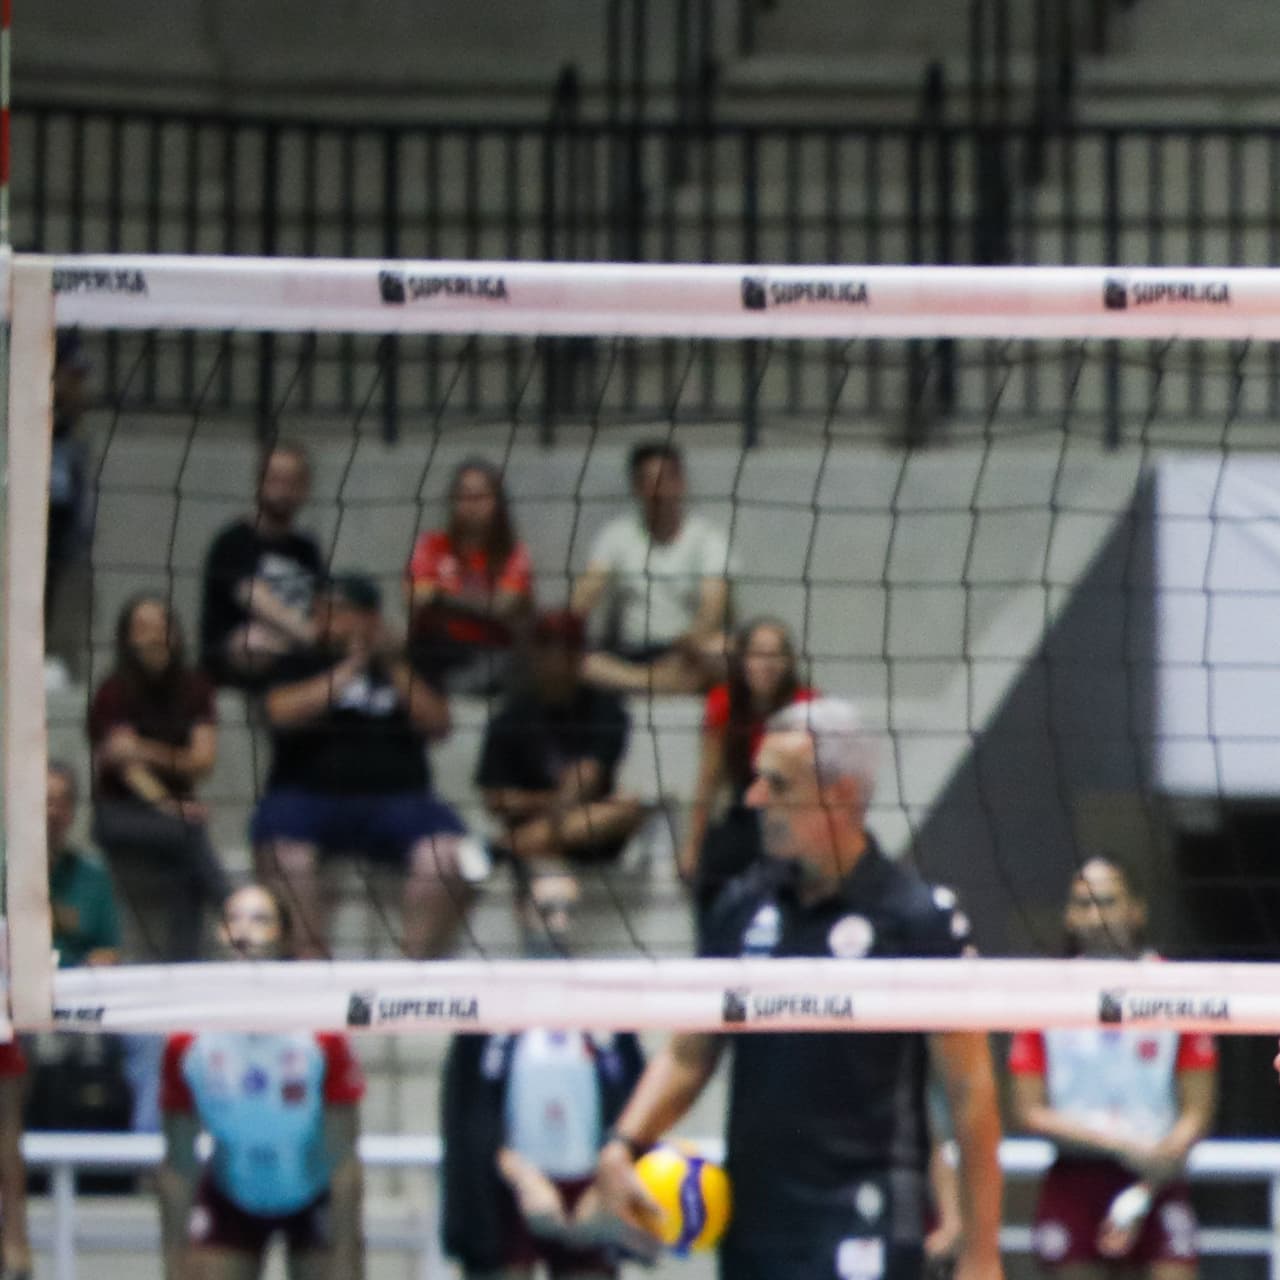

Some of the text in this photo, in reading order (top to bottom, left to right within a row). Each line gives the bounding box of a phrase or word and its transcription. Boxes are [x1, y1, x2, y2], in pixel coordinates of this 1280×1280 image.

[408, 275, 509, 299] SUPERLIGA
[770, 281, 868, 304] SUPERLIGA
[1132, 281, 1230, 304] SUPERLIGA
[379, 998, 479, 1019] SUPERLIGA
[753, 996, 854, 1019] SUPERLIGA
[1128, 997, 1231, 1020] SUPERLIGA
